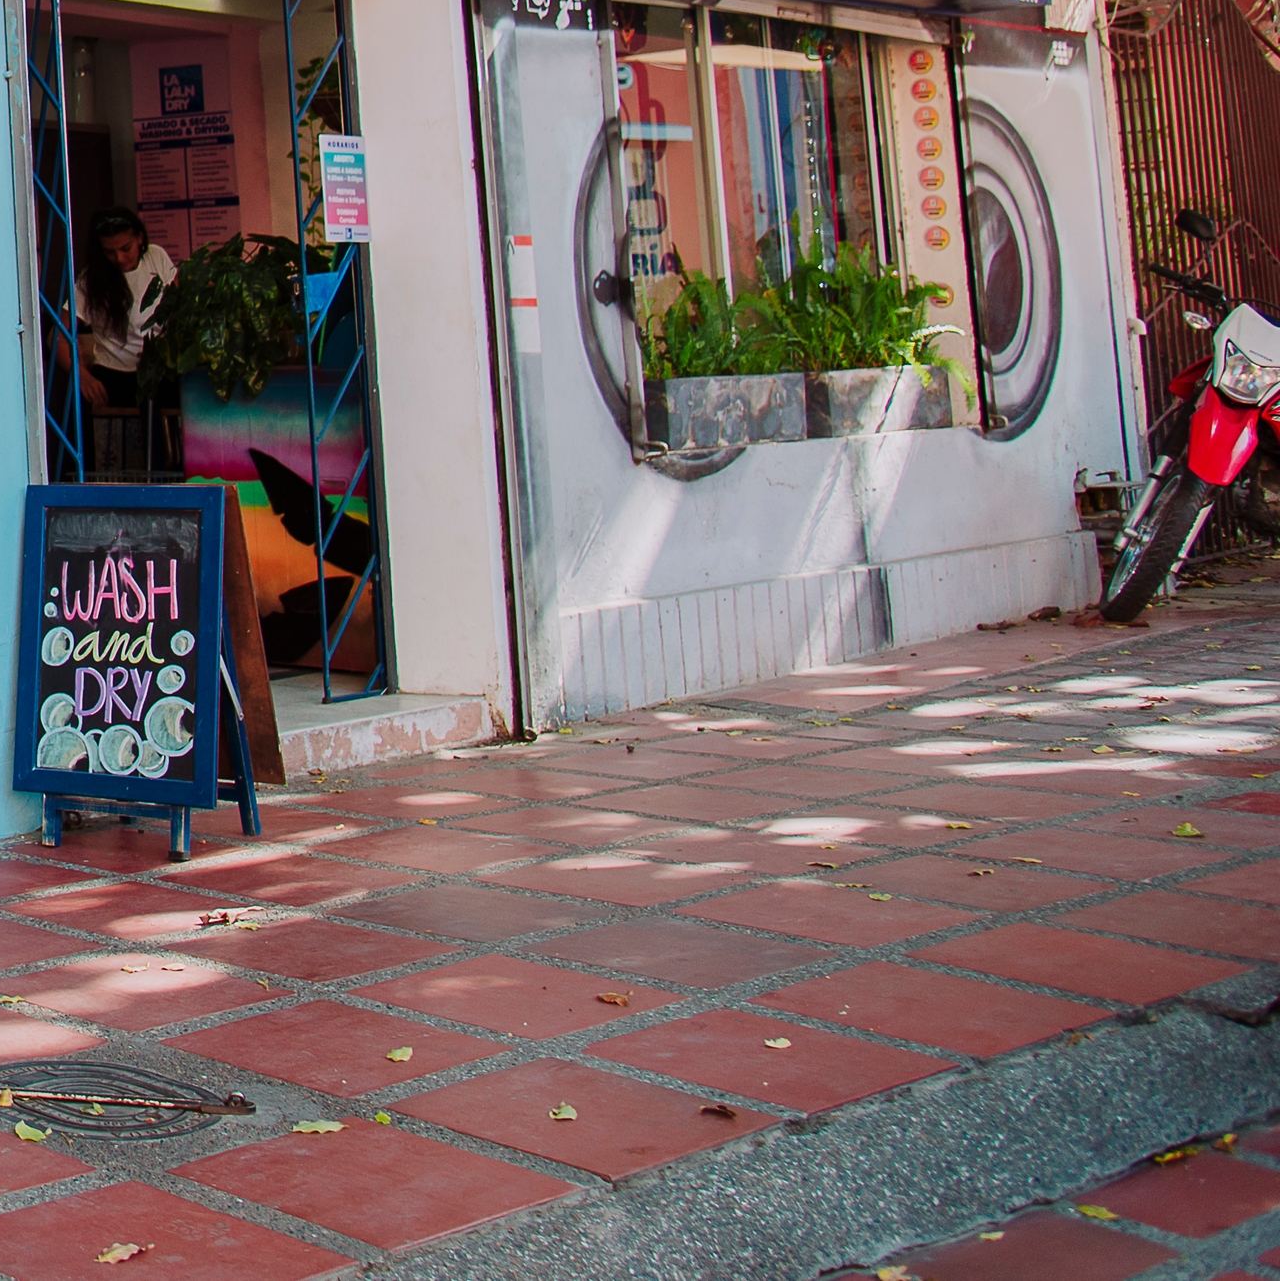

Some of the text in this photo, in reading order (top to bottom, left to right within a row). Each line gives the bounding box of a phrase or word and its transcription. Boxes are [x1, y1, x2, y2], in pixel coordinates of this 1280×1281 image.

[163, 73, 180, 87] LA
[142, 119, 177, 130] LAVADO
[189, 115, 226, 126] SECADO
[139, 128, 182, 139] WASHING
[195, 123, 230, 135] DRYING
[327, 141, 359, 149] HORARIOS
[61, 556, 179, 622] WASH
[73, 623, 165, 664] and
[74, 666, 153, 723] DRY
